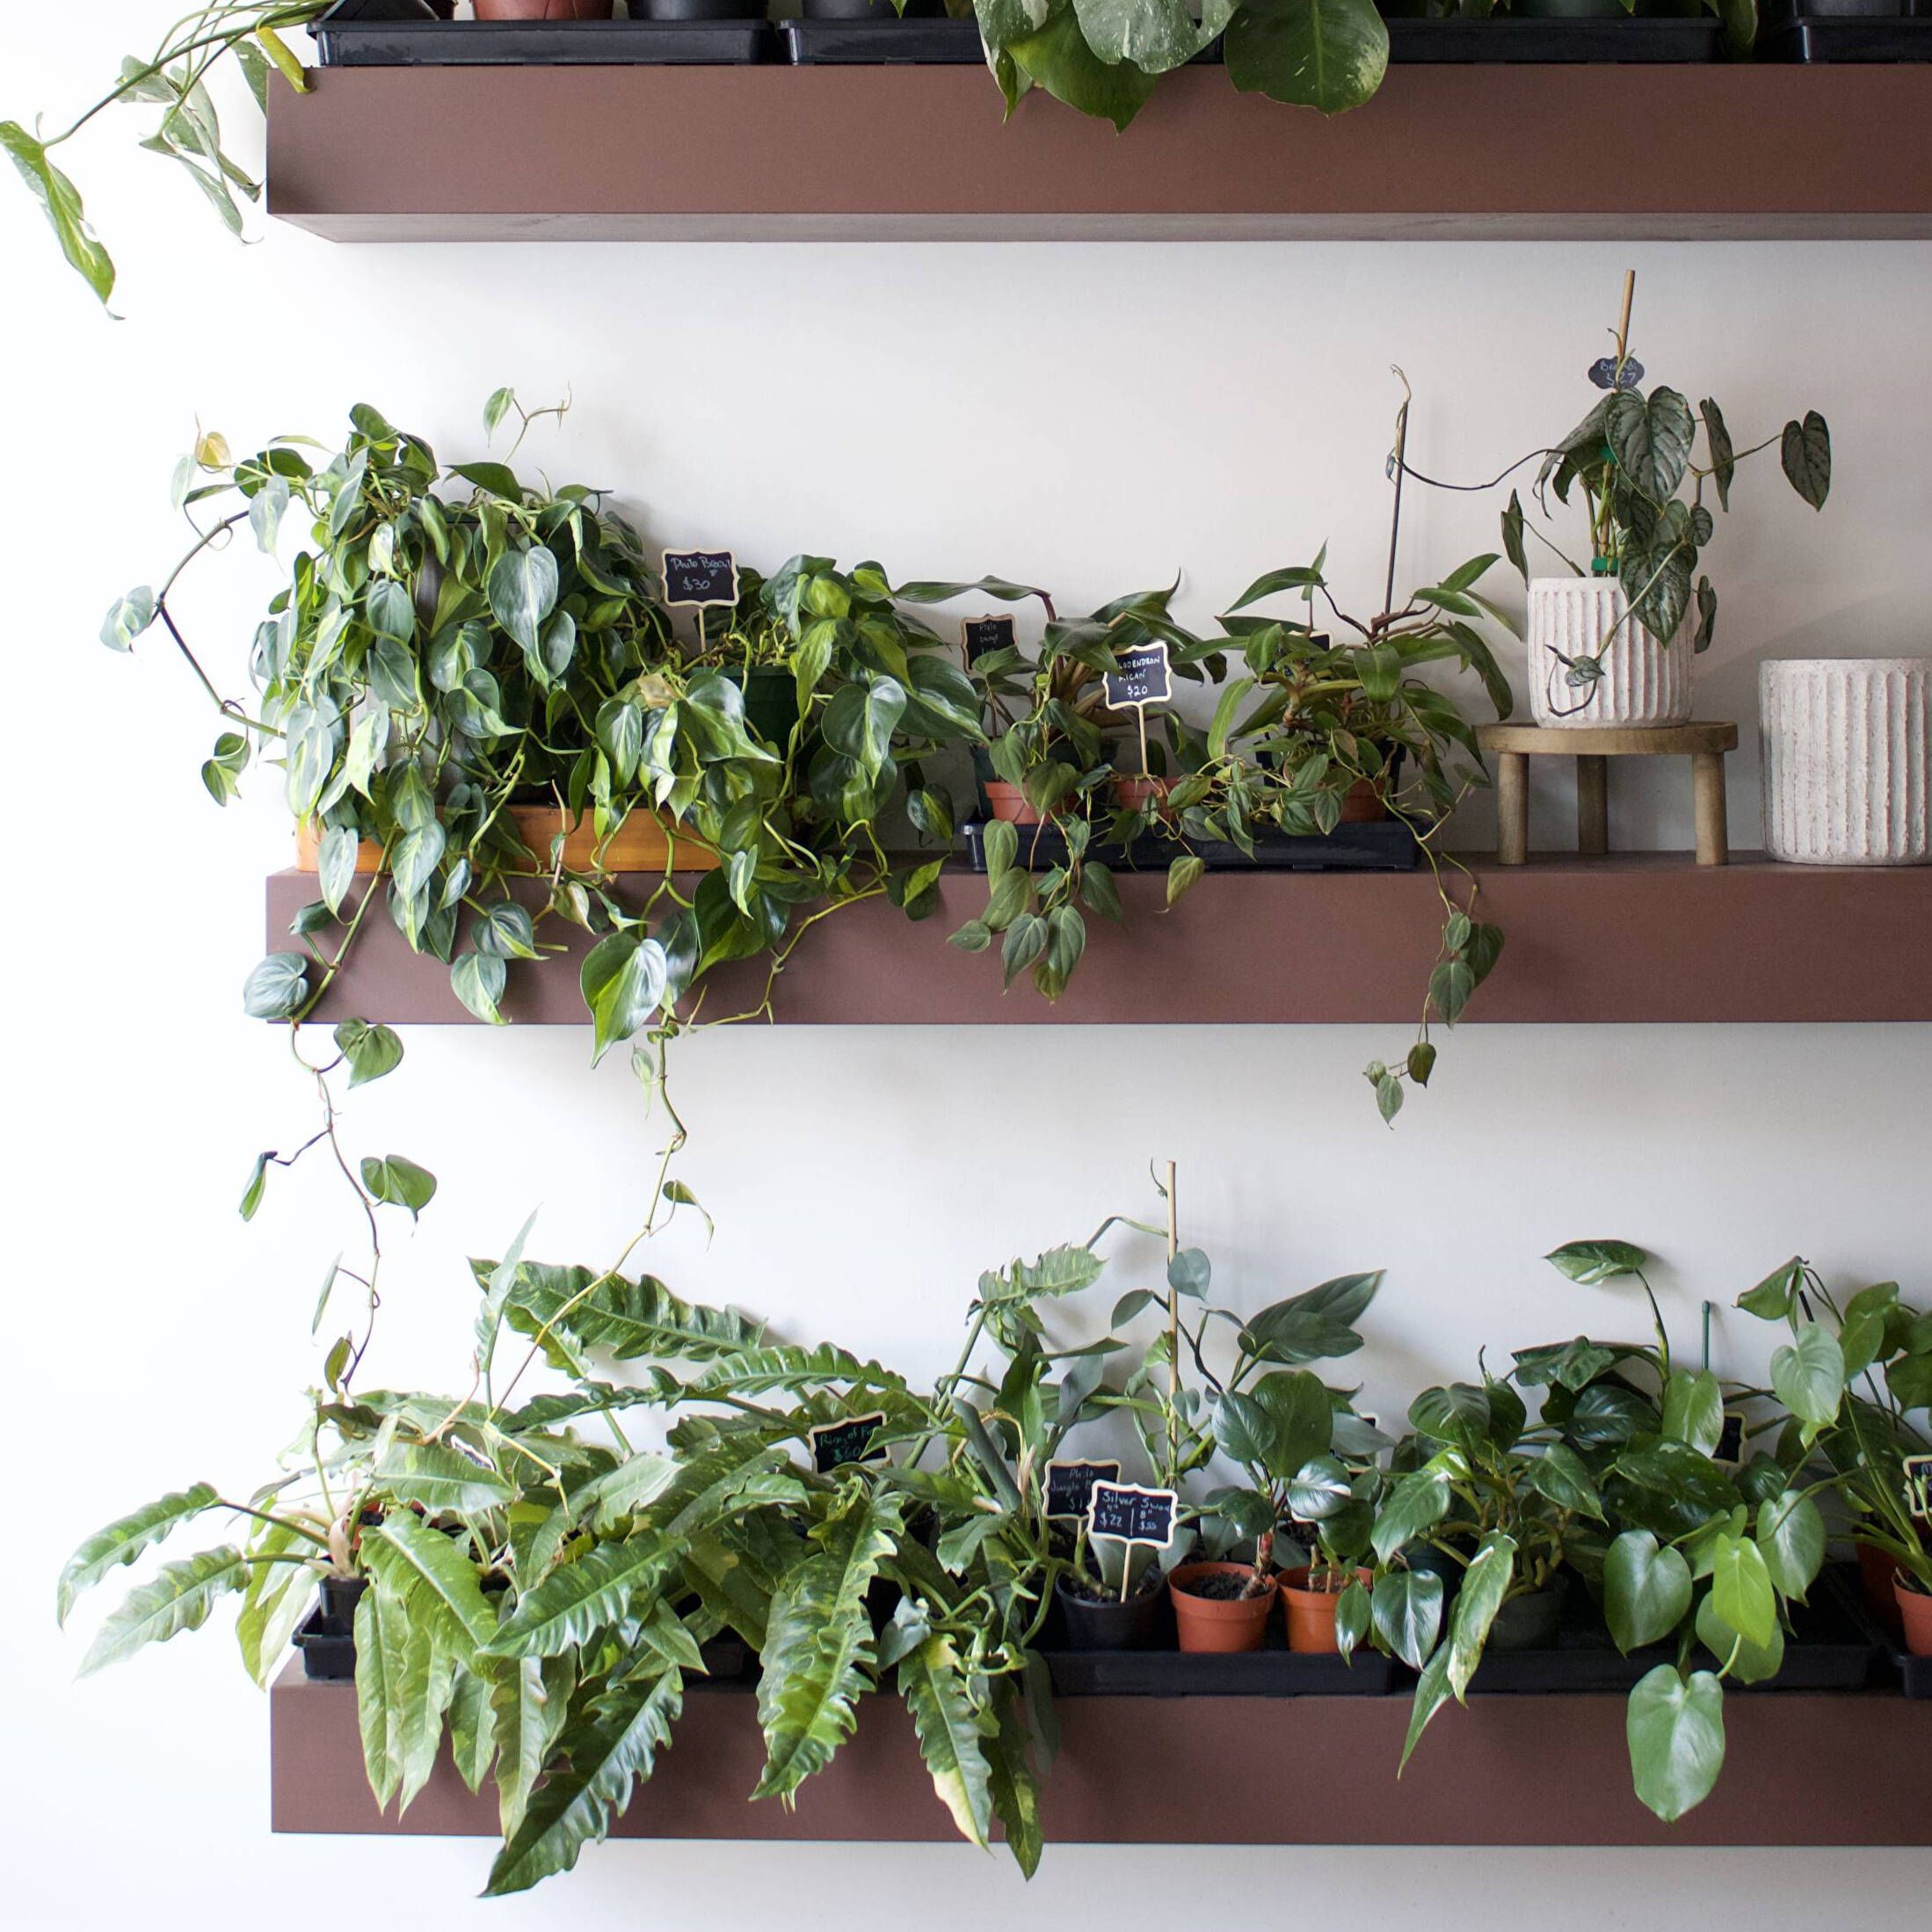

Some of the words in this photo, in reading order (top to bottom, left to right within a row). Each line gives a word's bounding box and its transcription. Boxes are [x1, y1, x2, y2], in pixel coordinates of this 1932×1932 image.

[683, 576, 710, 592] $30
[1127, 685, 1148, 699] $20
[1102, 1491, 1137, 1505] Silver
[1100, 1512, 1122, 1528] $22
